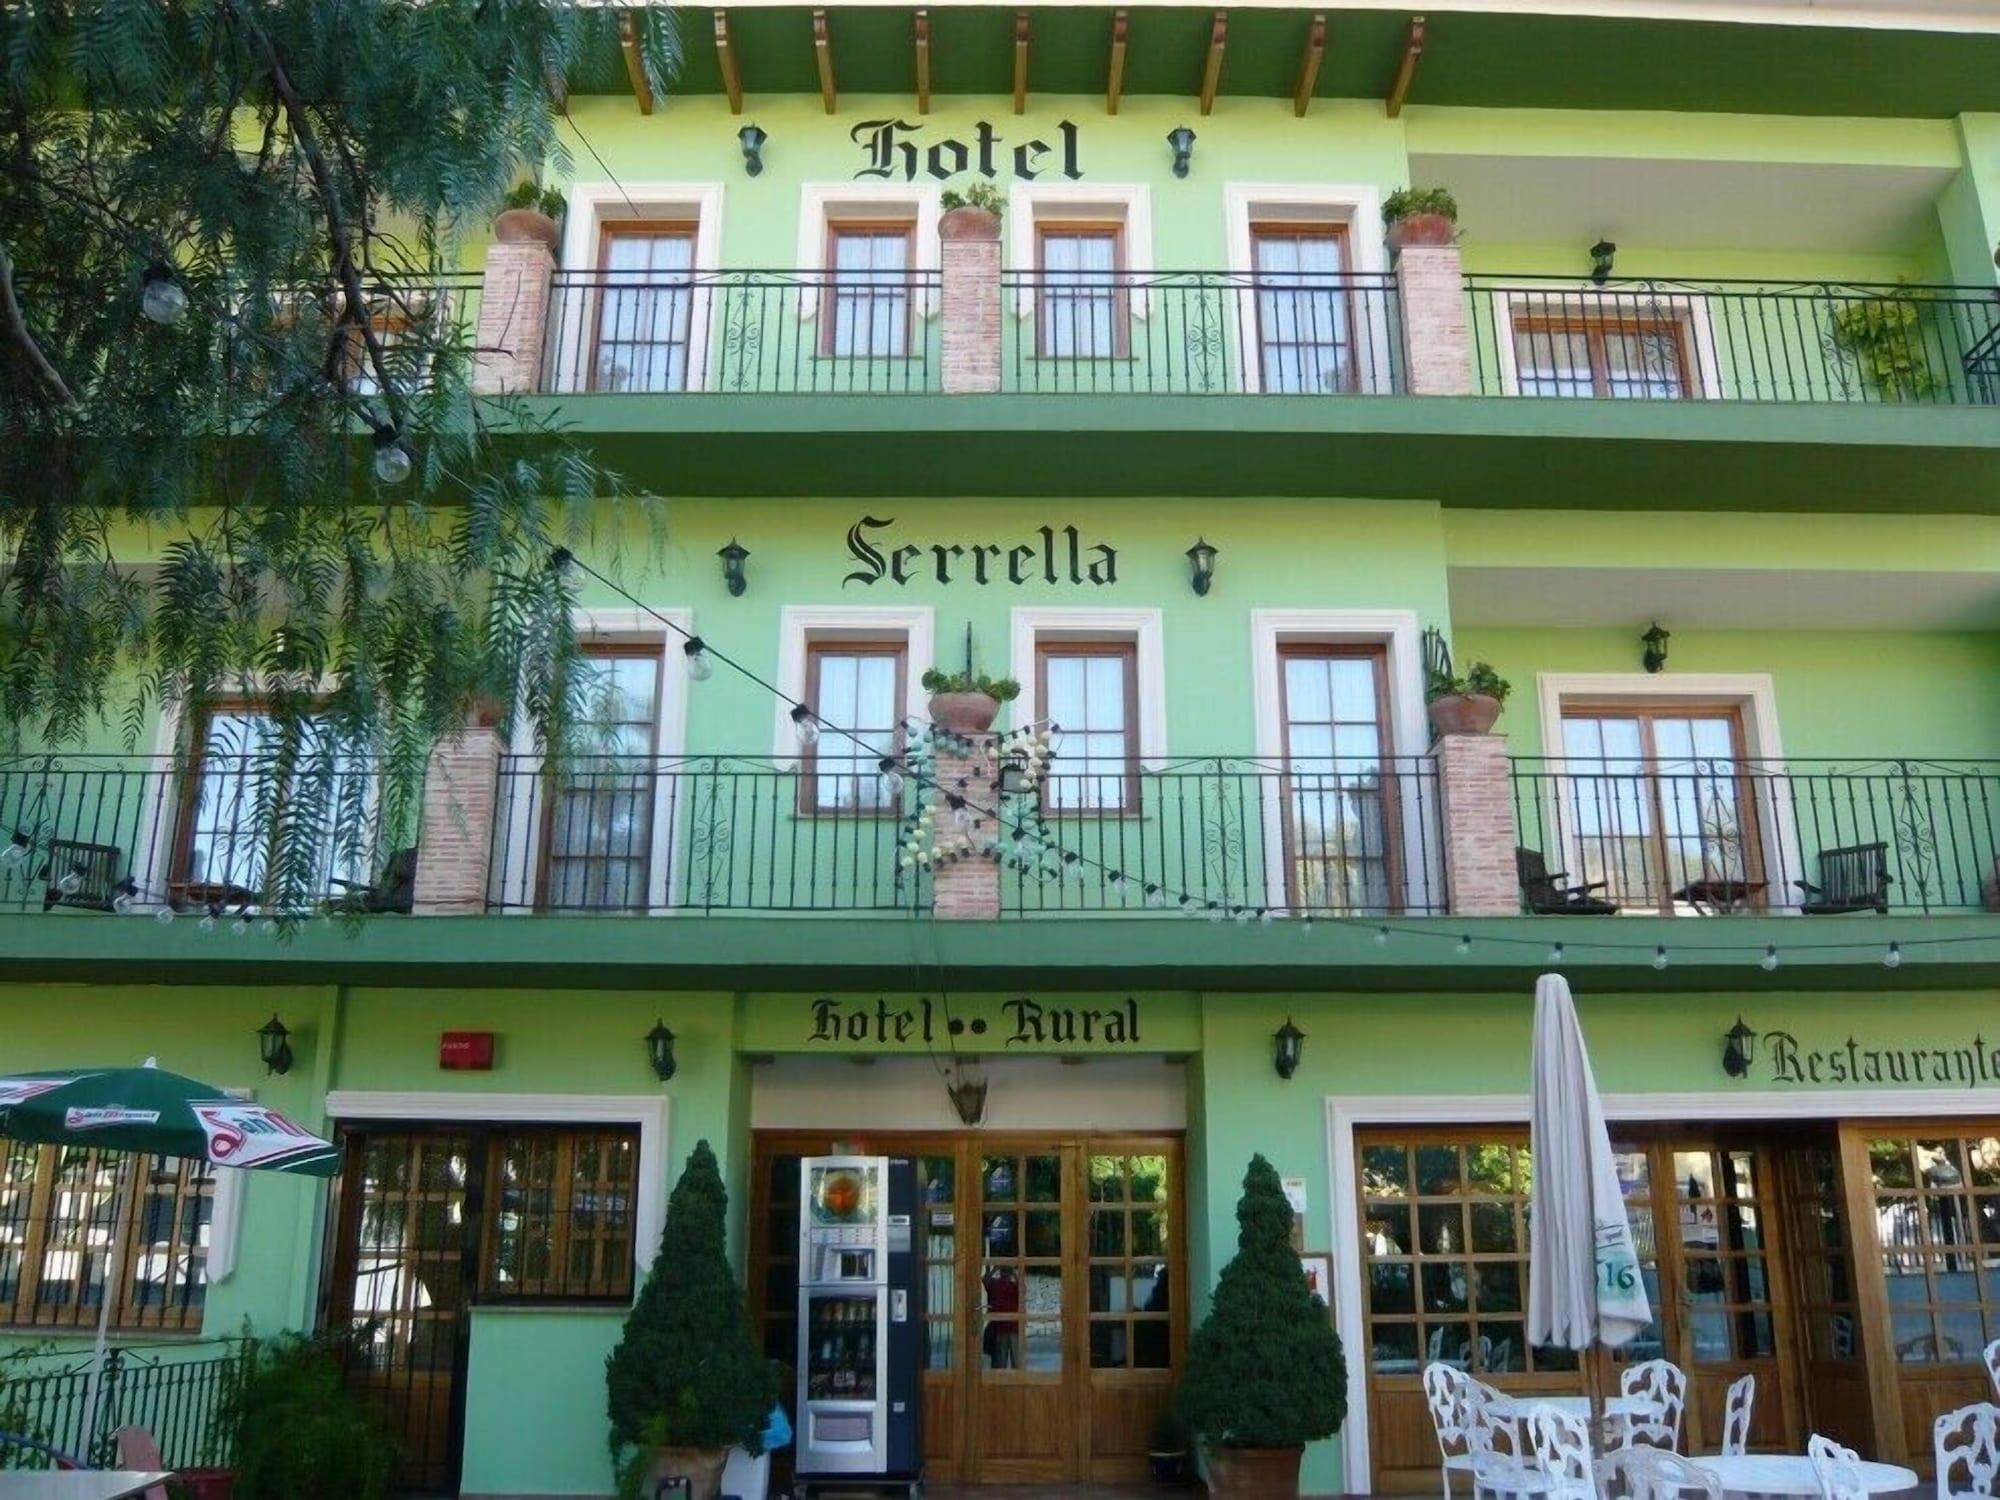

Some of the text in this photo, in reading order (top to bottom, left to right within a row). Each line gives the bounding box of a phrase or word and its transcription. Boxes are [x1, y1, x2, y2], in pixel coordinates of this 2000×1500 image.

[850, 118, 1085, 182] Hotel
[842, 515, 1118, 590] Serrella
[807, 998, 1140, 1047] Hotel Rural
